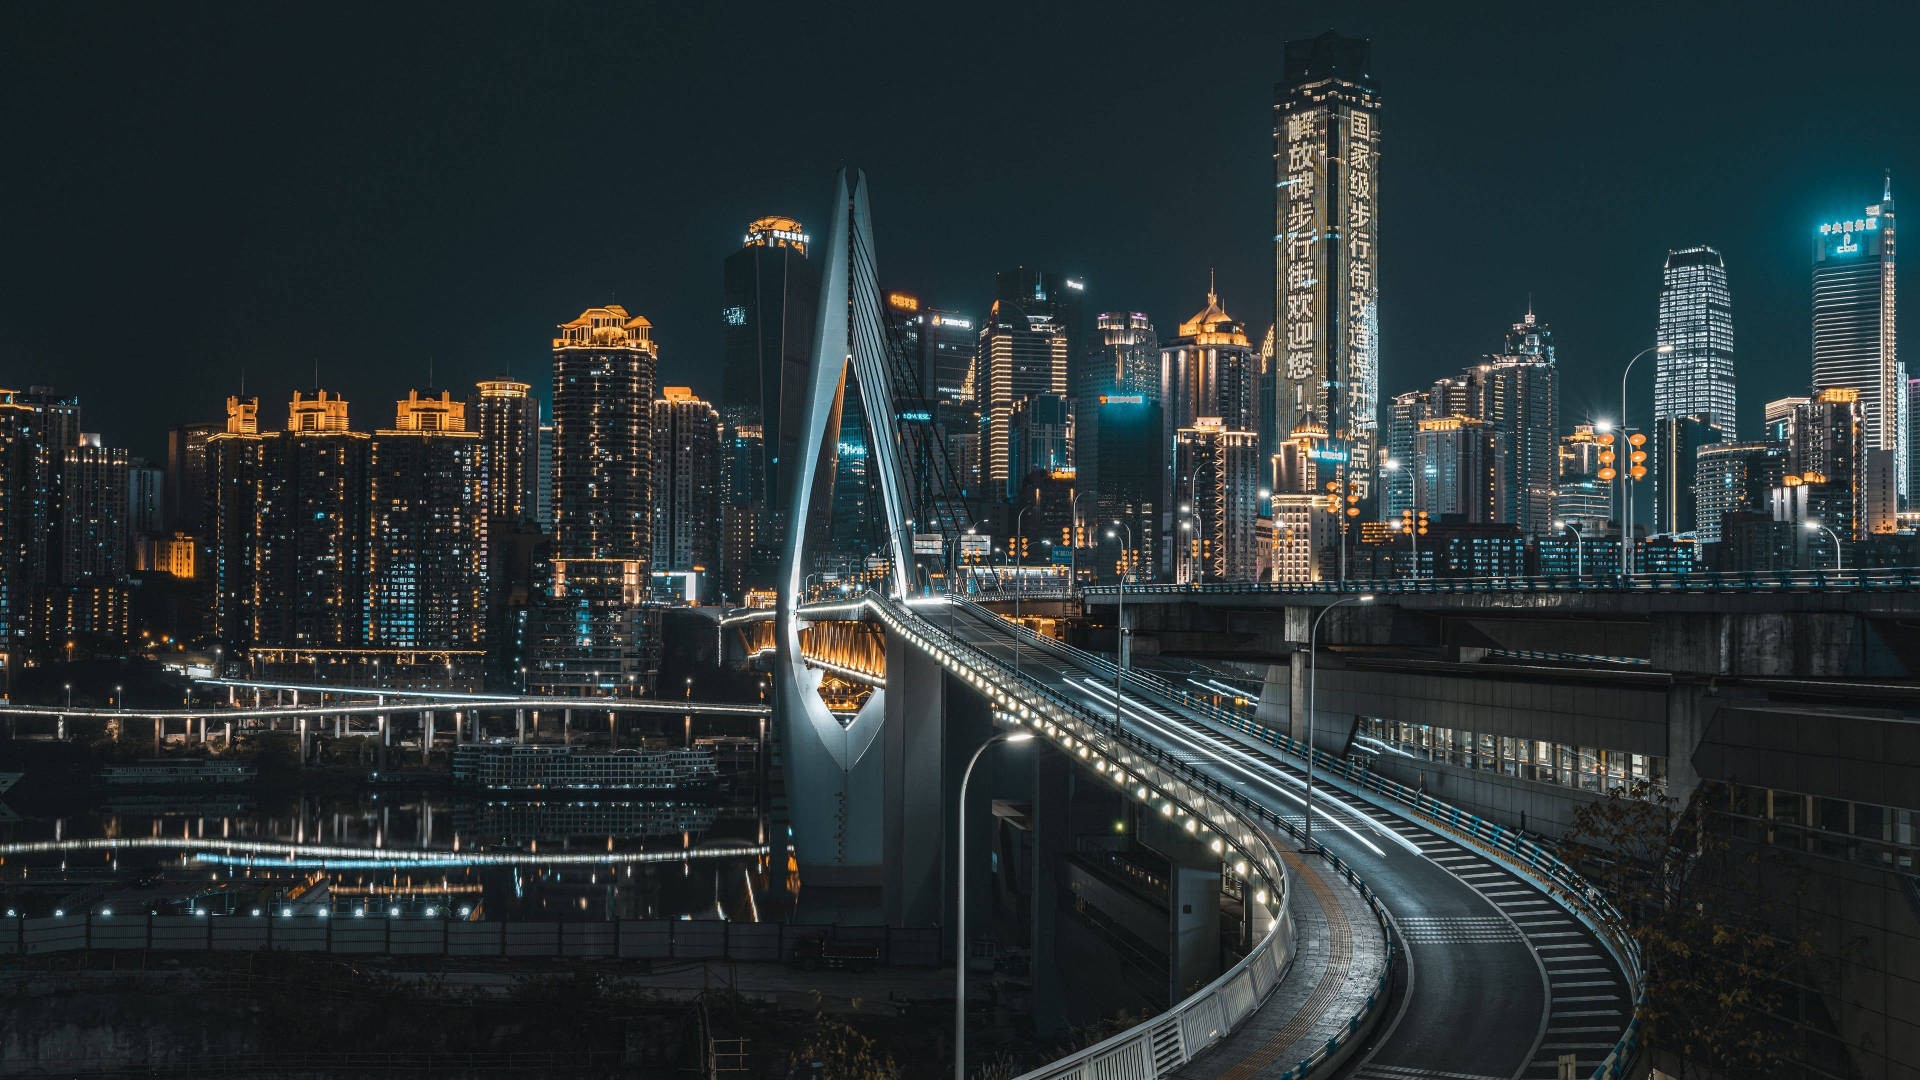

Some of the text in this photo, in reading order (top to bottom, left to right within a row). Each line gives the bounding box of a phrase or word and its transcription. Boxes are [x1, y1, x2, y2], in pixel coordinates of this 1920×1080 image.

[1820, 217, 1877, 236] 中央商务区
